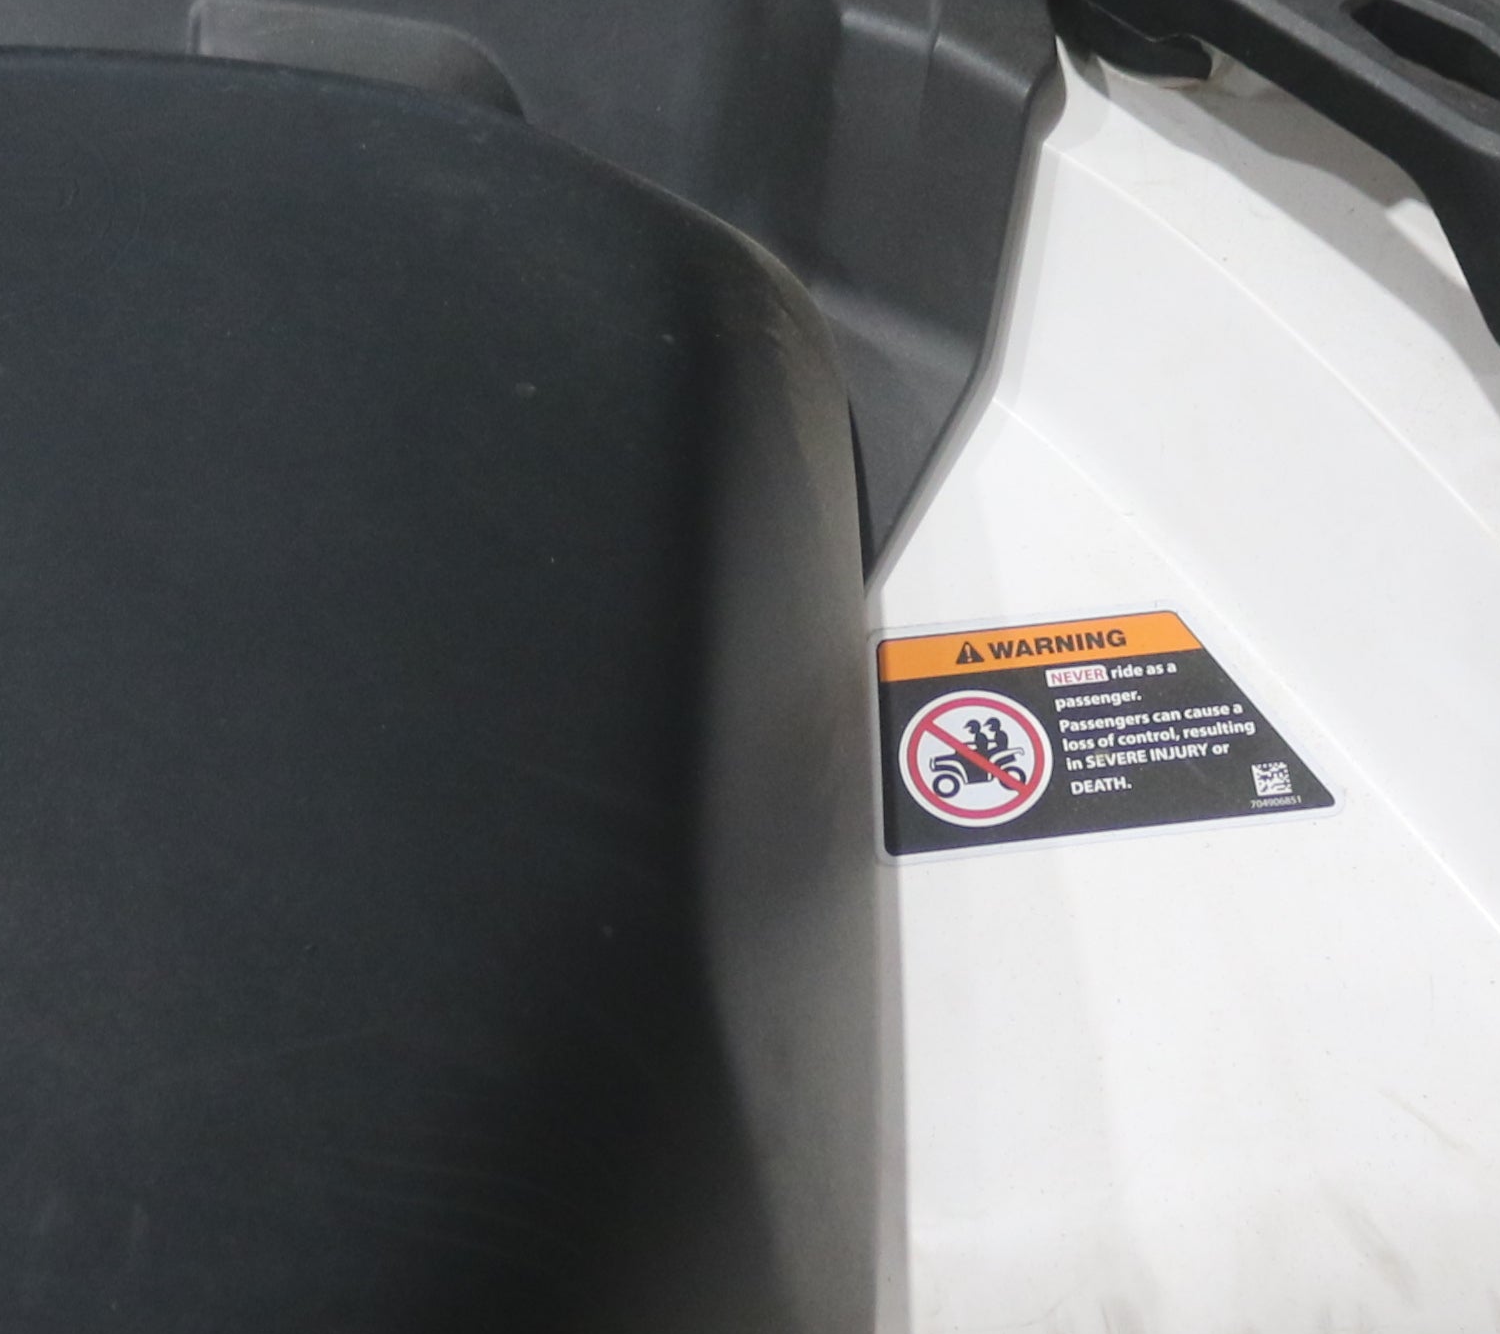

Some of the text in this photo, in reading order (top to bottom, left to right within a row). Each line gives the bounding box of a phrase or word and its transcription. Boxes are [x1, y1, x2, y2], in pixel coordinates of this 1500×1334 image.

[987, 629, 1127, 659] WARNING
[1050, 662, 1177, 685] NEVER ride as a
[1054, 690, 1142, 711] passenger.
[1058, 703, 1243, 732] Passengers can cause a
[1062, 720, 1256, 751] loss of control, resulting
[1065, 742, 1230, 771] in SEVERE INJURY or
[1070, 776, 1132, 794] DEATH.
